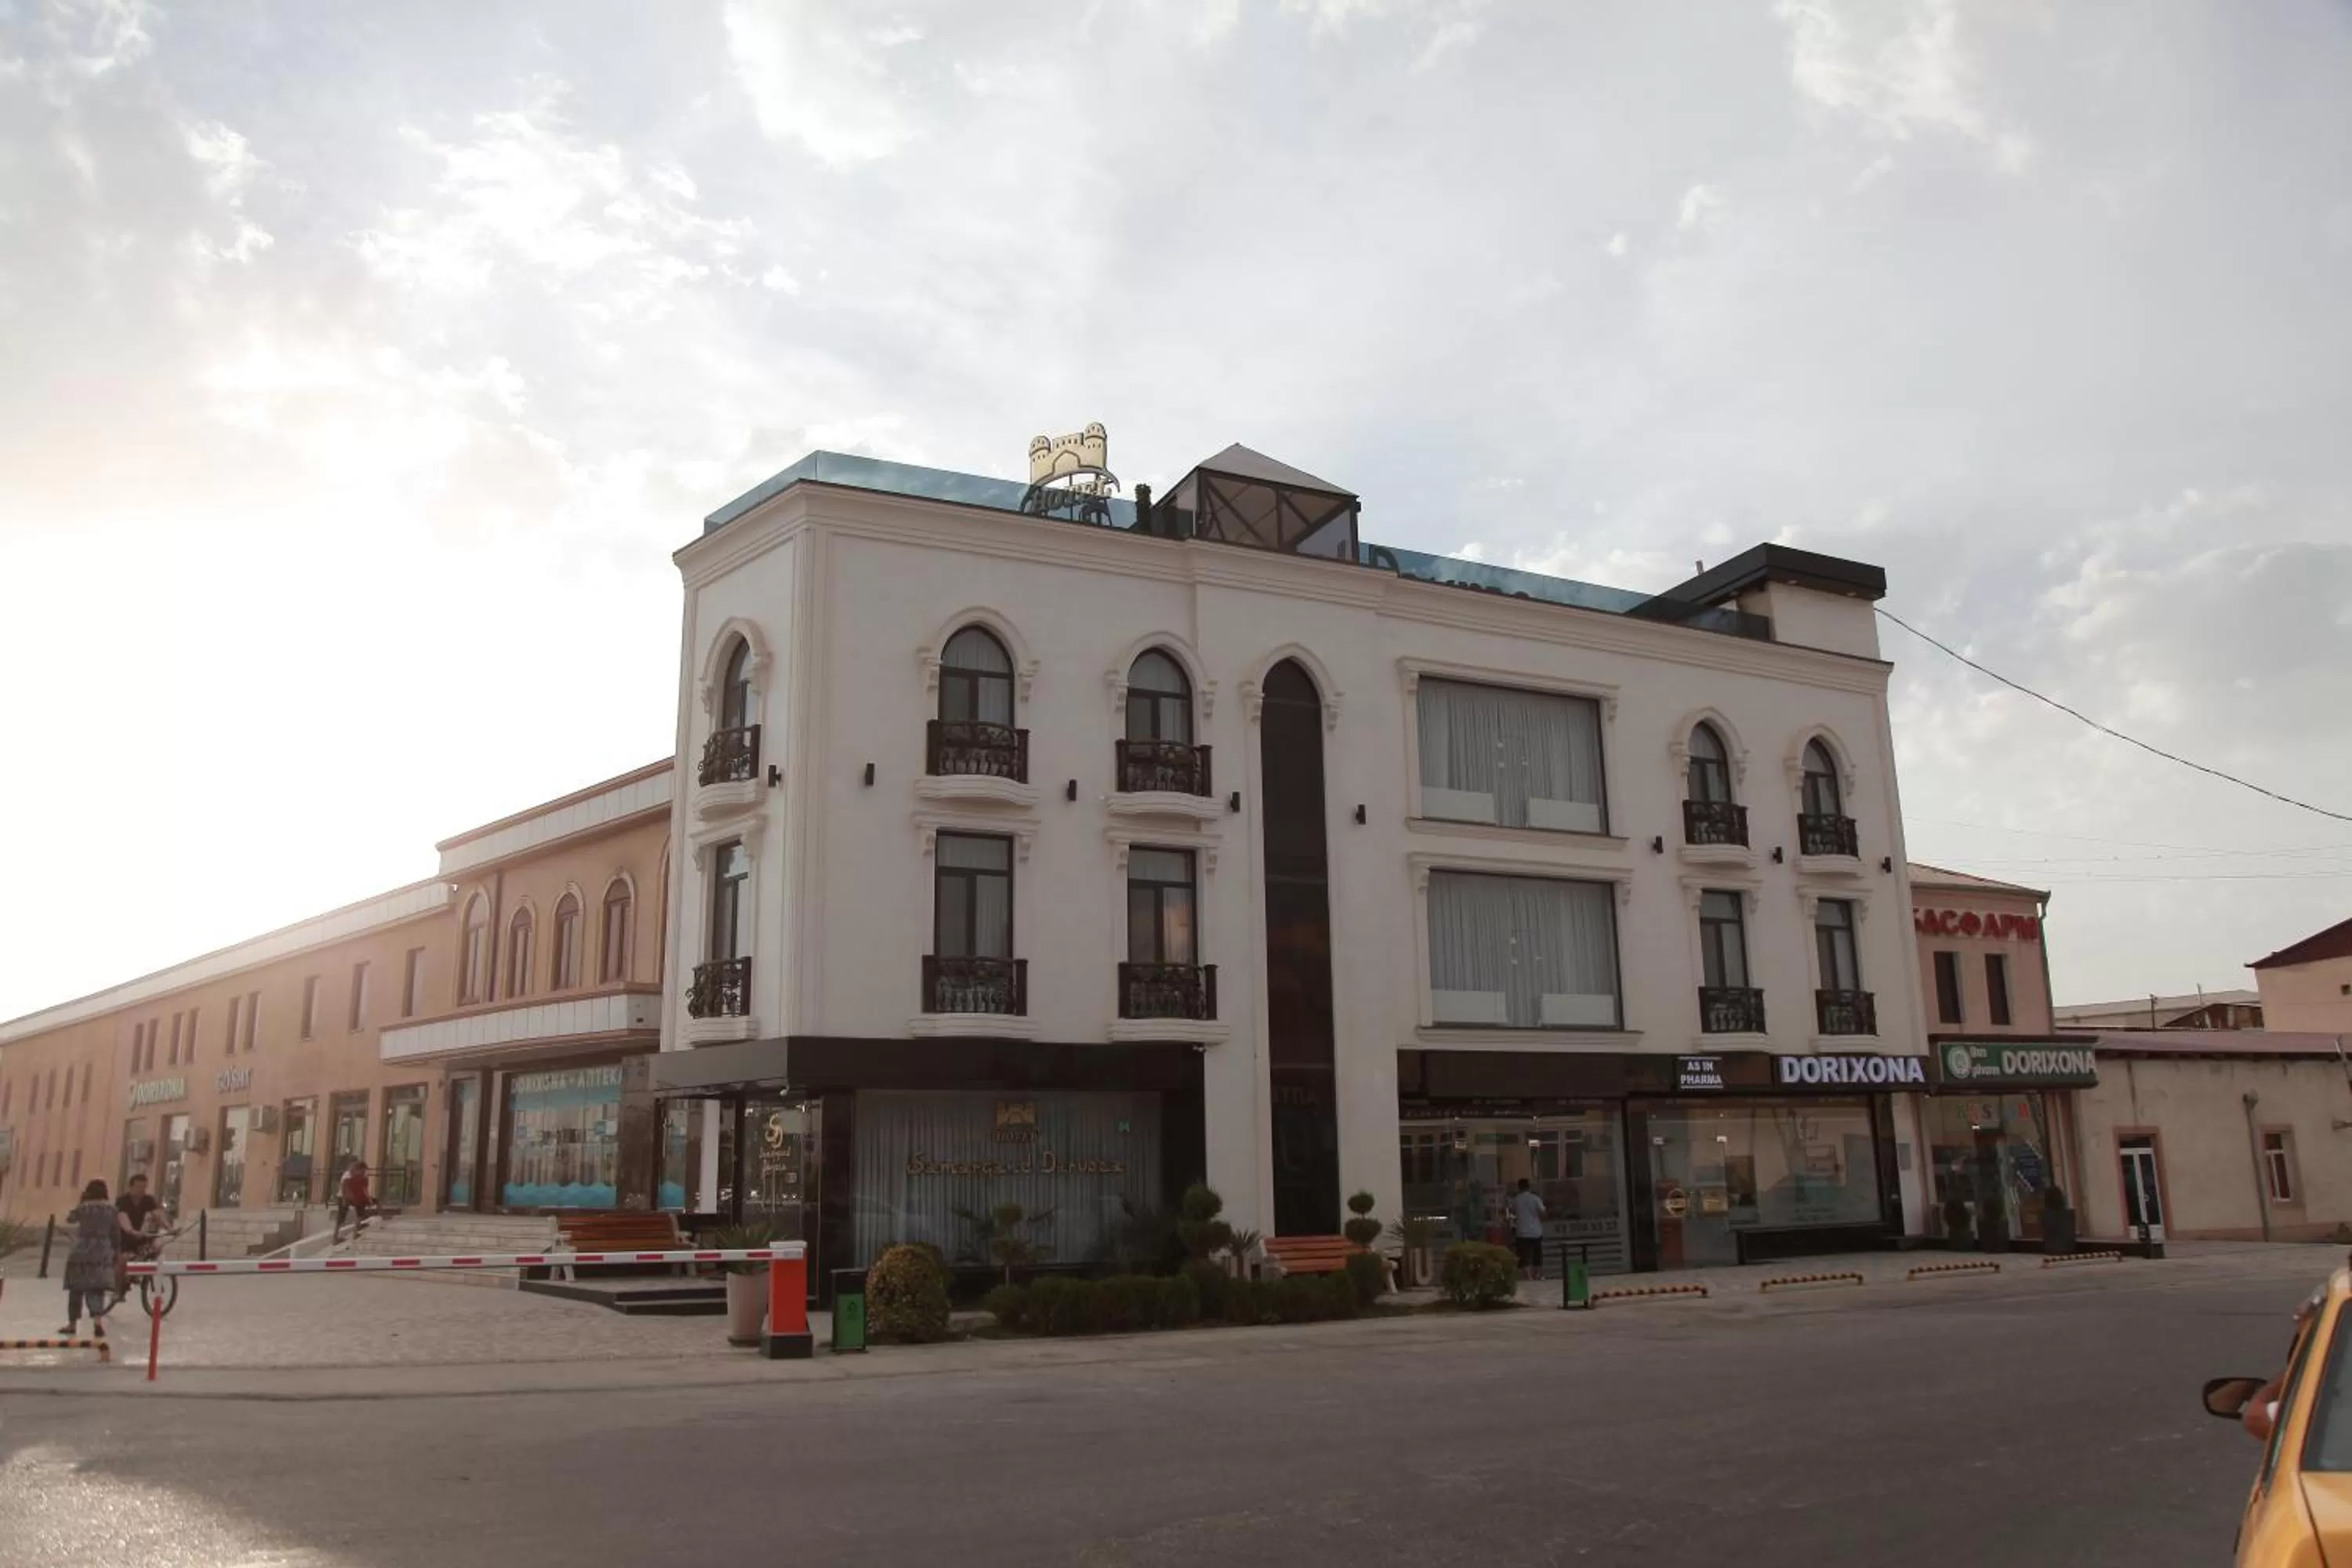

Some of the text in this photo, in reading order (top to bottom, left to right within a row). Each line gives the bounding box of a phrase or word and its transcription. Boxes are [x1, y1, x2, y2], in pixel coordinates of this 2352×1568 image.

[1780, 1056, 1926, 1083] DORIXONA
[2001, 1049, 2098, 1076] DORIXONA
[1680, 1073, 1722, 1084] PHARMA
